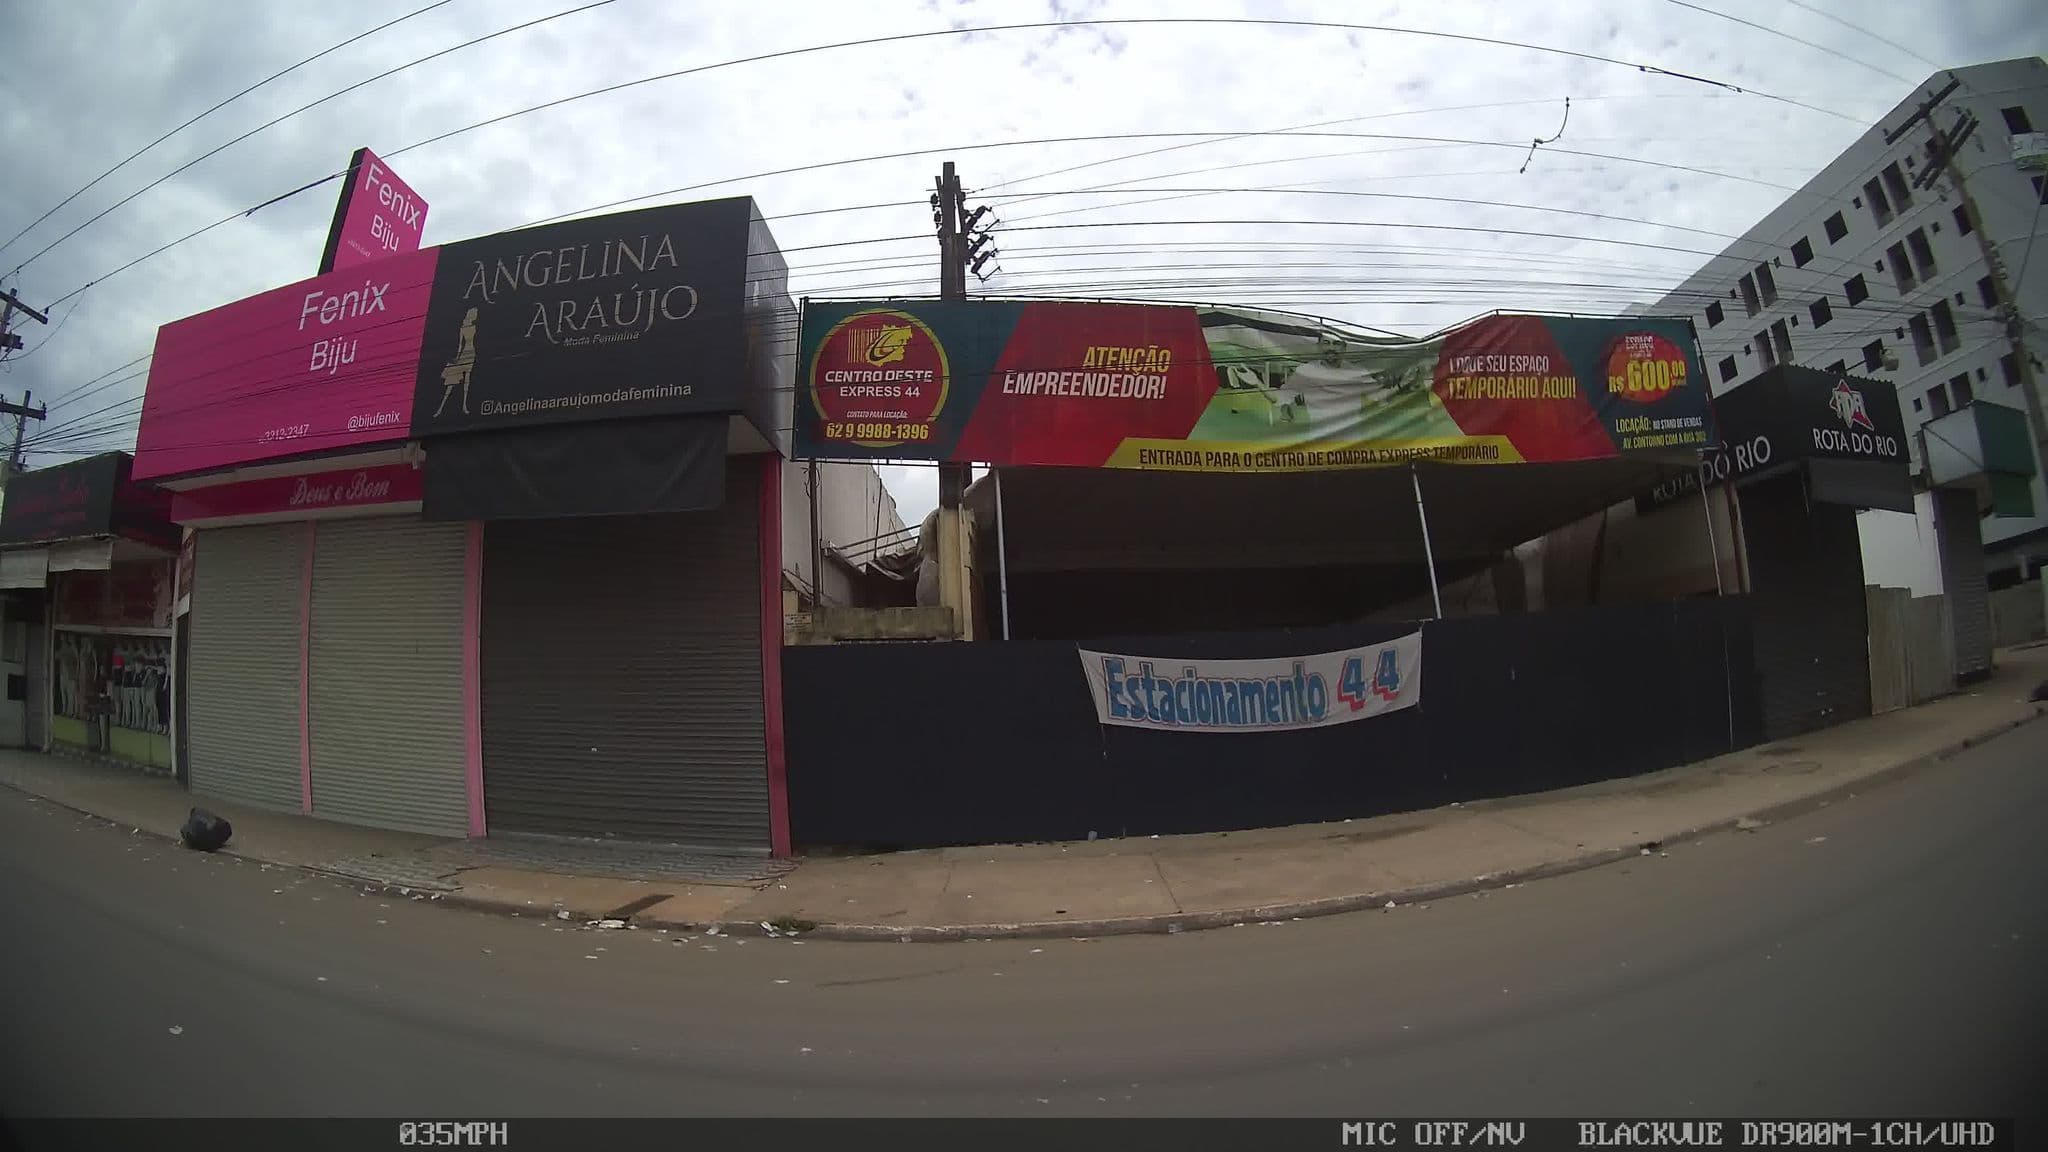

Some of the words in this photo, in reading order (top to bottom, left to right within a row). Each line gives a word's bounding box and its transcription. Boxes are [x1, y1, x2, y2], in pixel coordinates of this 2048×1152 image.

[365, 163, 420, 231] Fenix
[371, 214, 400, 252] Biju
[463, 234, 679, 304] ANGELINA
[299, 280, 390, 330] Fenix
[524, 283, 698, 344] ARAÚJO
[310, 337, 357, 374] Biju
[1083, 345, 1172, 376] ATENÇÃO
[1486, 355, 1507, 372] SEU
[1509, 355, 1549, 375] ESPAÇO
[825, 370, 883, 383] CENTRO
[885, 370, 933, 383] OESTE
[1002, 370, 1168, 399] EMPREENDEDOR!
[1447, 373, 1538, 399] TEMPORÁRIO
[1541, 377, 1576, 399] AQUI!
[1608, 375, 1624, 394] R$
[840, 386, 901, 397] EXPRESS
[905, 386, 920, 397] 44
[347, 411, 400, 432] @bijufenix
[826, 423, 843, 438] 62
[846, 424, 854, 437] 9
[856, 423, 929, 440] 9988-1396
[1139, 449, 1202, 466] ENTRADA
[1206, 452, 1240, 467] PARA
[1243, 453, 1251, 467] O
[1256, 453, 1304, 467] CENTRO
[1308, 452, 1323, 465] DE
[1327, 450, 1377, 465] COMPRA
[1380, 446, 1430, 462] EXPRESS
[1737, 435, 1772, 472] RIO
[1813, 428, 1850, 452] ROTA
[1853, 432, 1873, 454] DO
[1877, 436, 1897, 456] RIO
[1101, 656, 1328, 727] Estacionamento
